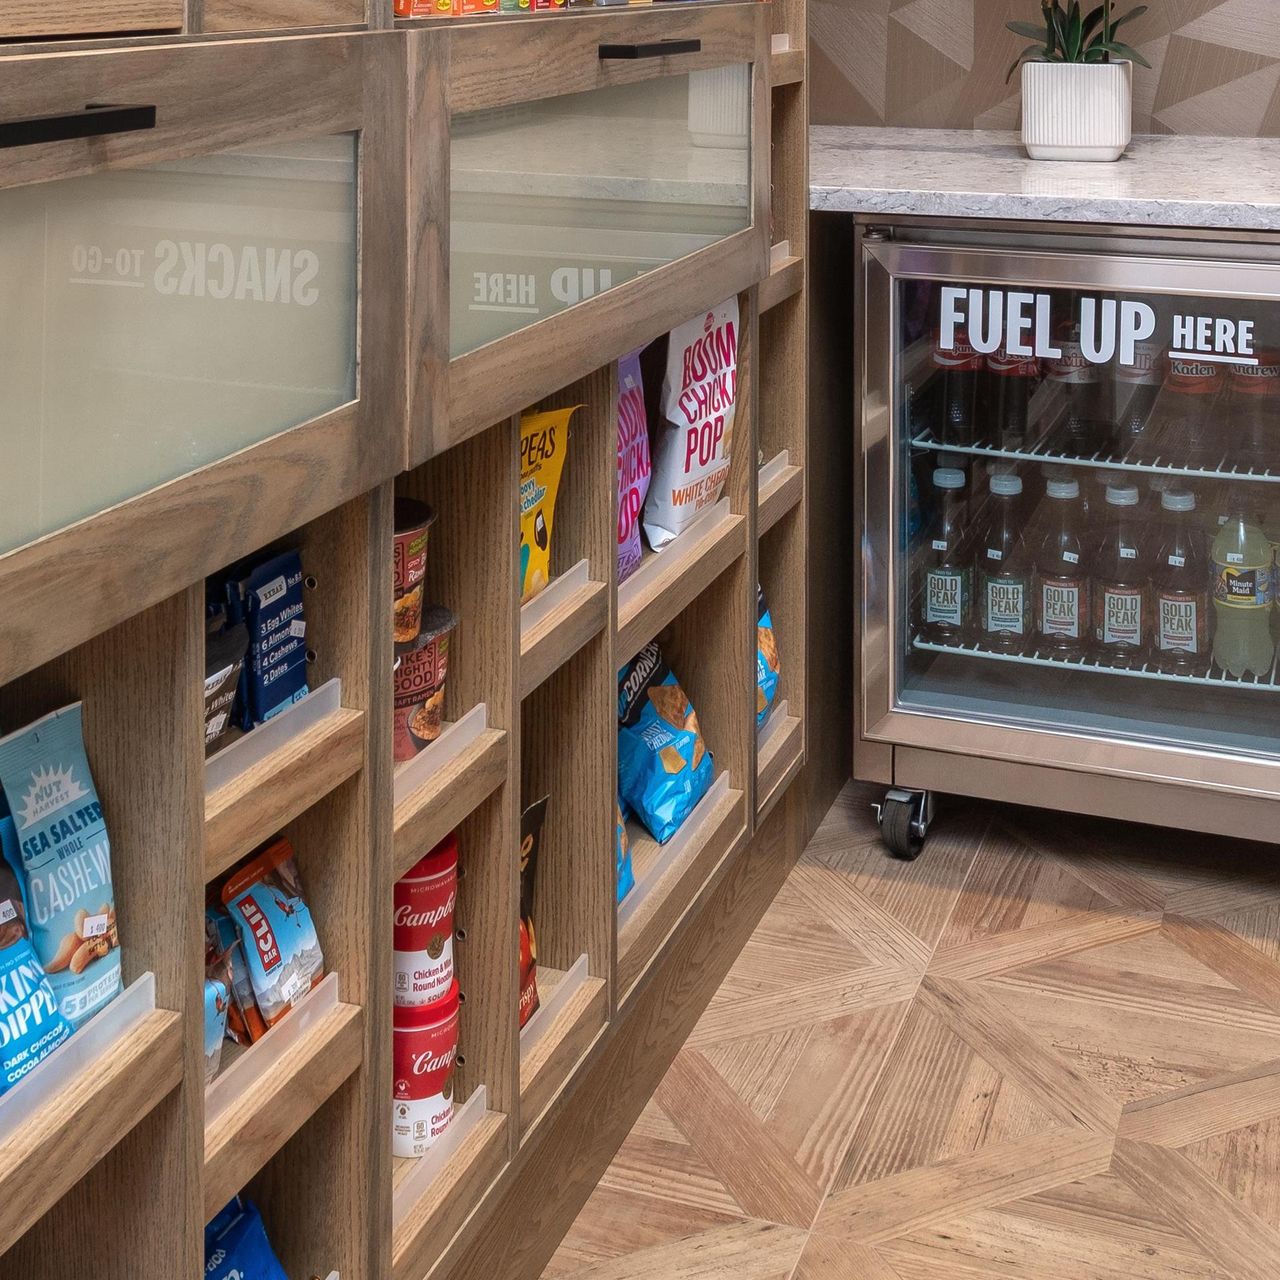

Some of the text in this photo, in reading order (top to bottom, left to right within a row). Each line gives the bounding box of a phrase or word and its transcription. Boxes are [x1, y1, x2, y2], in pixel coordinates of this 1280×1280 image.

[940, 286, 1254, 365] FUEL UP HERE
[682, 321, 737, 391] BOOM
[1171, 360, 1216, 376] Kaden
[685, 414, 725, 474] POP
[672, 486, 702, 507] WHITE
[930, 576, 957, 591] GOLD
[991, 585, 1019, 600] GOLD
[1230, 580, 1253, 588] Minute
[930, 591, 957, 604] PEAK
[1046, 588, 1074, 603] GOLD
[1108, 596, 1137, 611] GOLD
[991, 600, 1019, 613] PEAK
[1046, 602, 1074, 616] PEAK
[1162, 602, 1192, 617] GOLD
[261, 601, 304, 634] 3 Egg Whites
[1108, 610, 1137, 624] PEAK
[1163, 616, 1192, 631] PEAK
[261, 627, 291, 651] 6 Almon
[262, 639, 298, 667] 4 Cashews
[263, 663, 288, 686] 2 Dates
[34, 780, 63, 804] NUT
[32, 790, 70, 819] HARVEST
[22, 835, 50, 862] SEA
[56, 837, 83, 861] WHOLE
[242, 902, 273, 952] CLIF
[264, 950, 277, 963] BAR
[414, 965, 439, 980] Chicken
[413, 978, 436, 993] Round
[3, 1051, 29, 1071] DARK
[7, 1060, 39, 1083] COCOA
